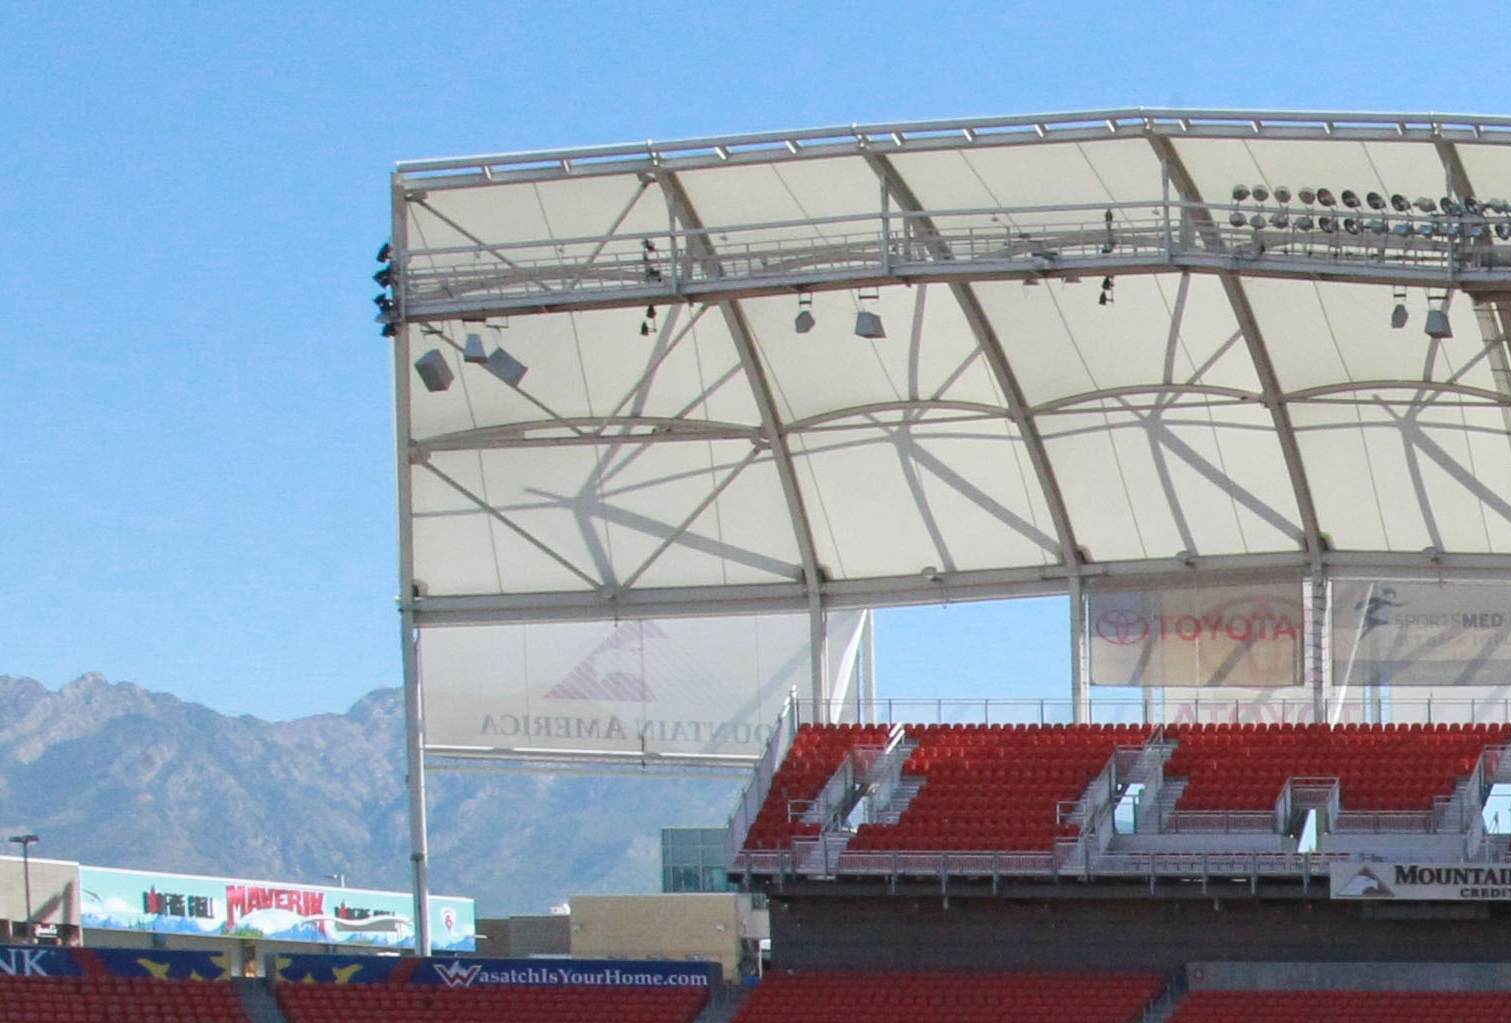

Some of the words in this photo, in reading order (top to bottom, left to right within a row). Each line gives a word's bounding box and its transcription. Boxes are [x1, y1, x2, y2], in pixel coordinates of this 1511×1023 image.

[1155, 614, 1298, 641] TOYOTA
[226, 885, 327, 935] MAVERIK
[433, 961, 708, 988] WasatchIsYourHome.com
